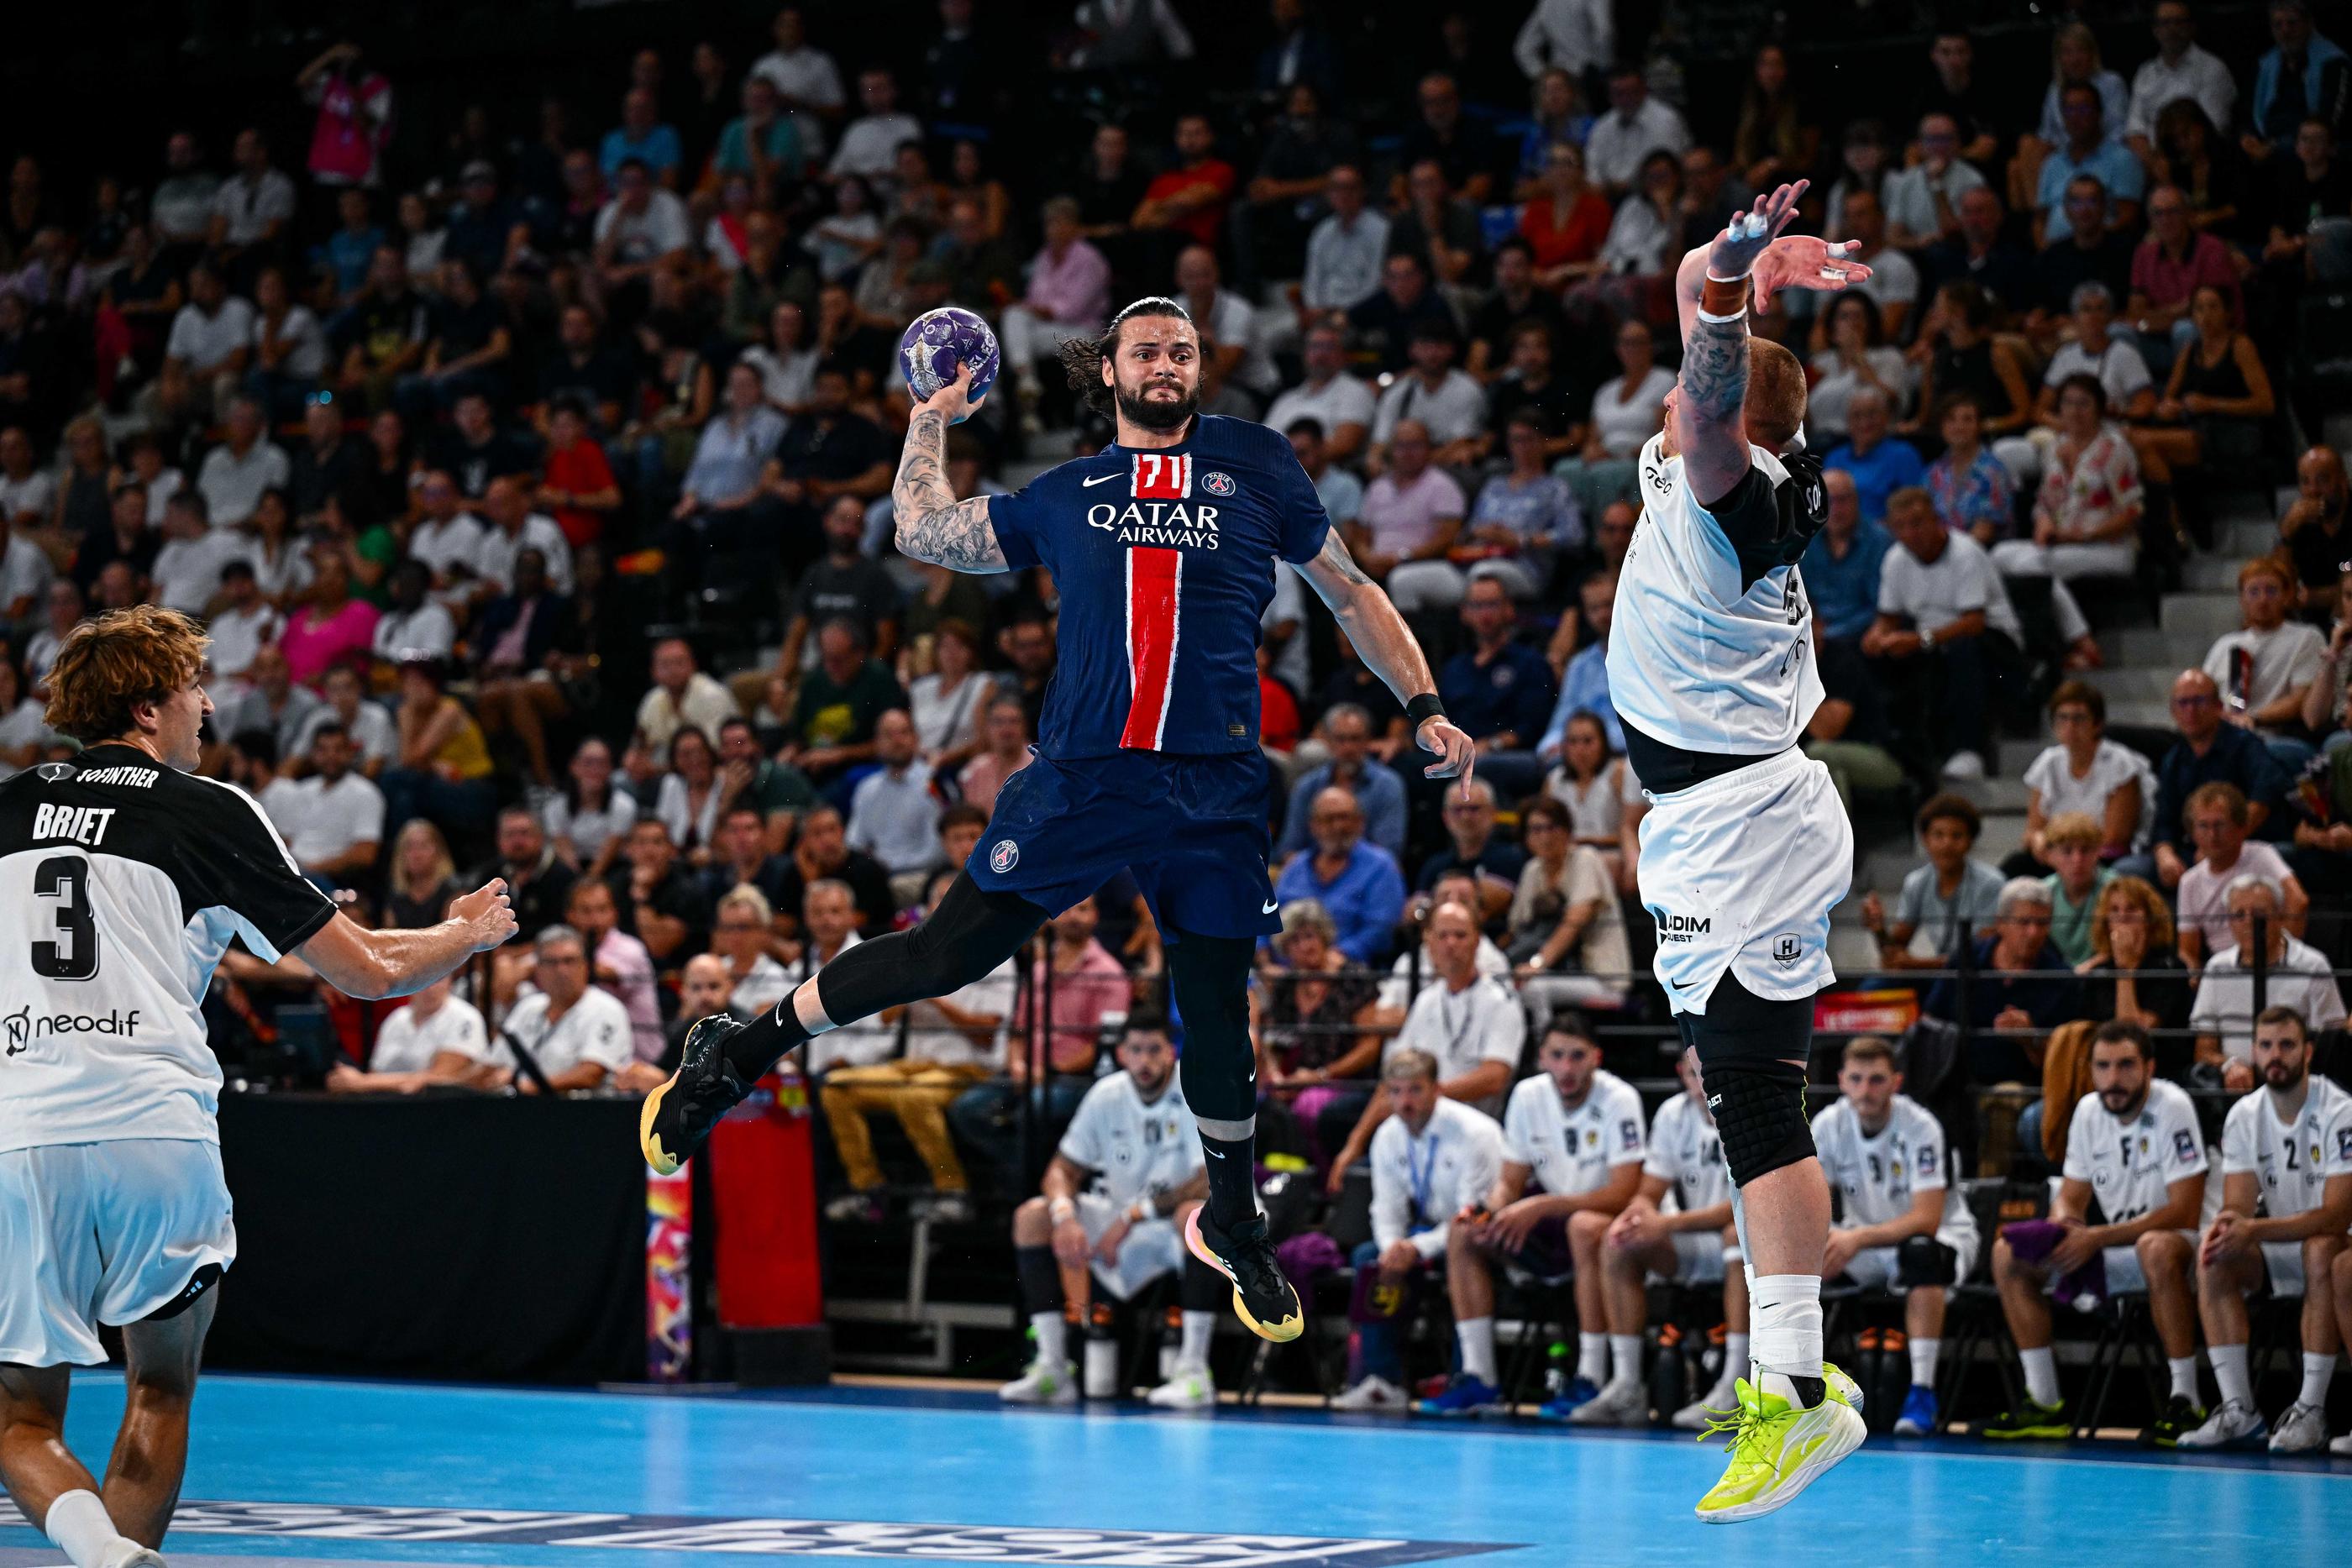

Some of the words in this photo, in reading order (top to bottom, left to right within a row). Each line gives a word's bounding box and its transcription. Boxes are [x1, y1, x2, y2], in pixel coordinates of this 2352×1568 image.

[1142, 454, 1180, 489] 71
[1208, 474, 1231, 482] PARIS
[1088, 502, 1220, 532] QATAR
[1117, 527, 1219, 550] AIRWAYS
[76, 766, 160, 789] SOFINTHER
[33, 803, 116, 846] BRIET
[1001, 842, 1017, 854] PARIS
[31, 855, 100, 981] 3
[1782, 940, 1793, 954] H
[36, 1009, 140, 1038] neodif
[2283, 1138, 2299, 1171] 2
